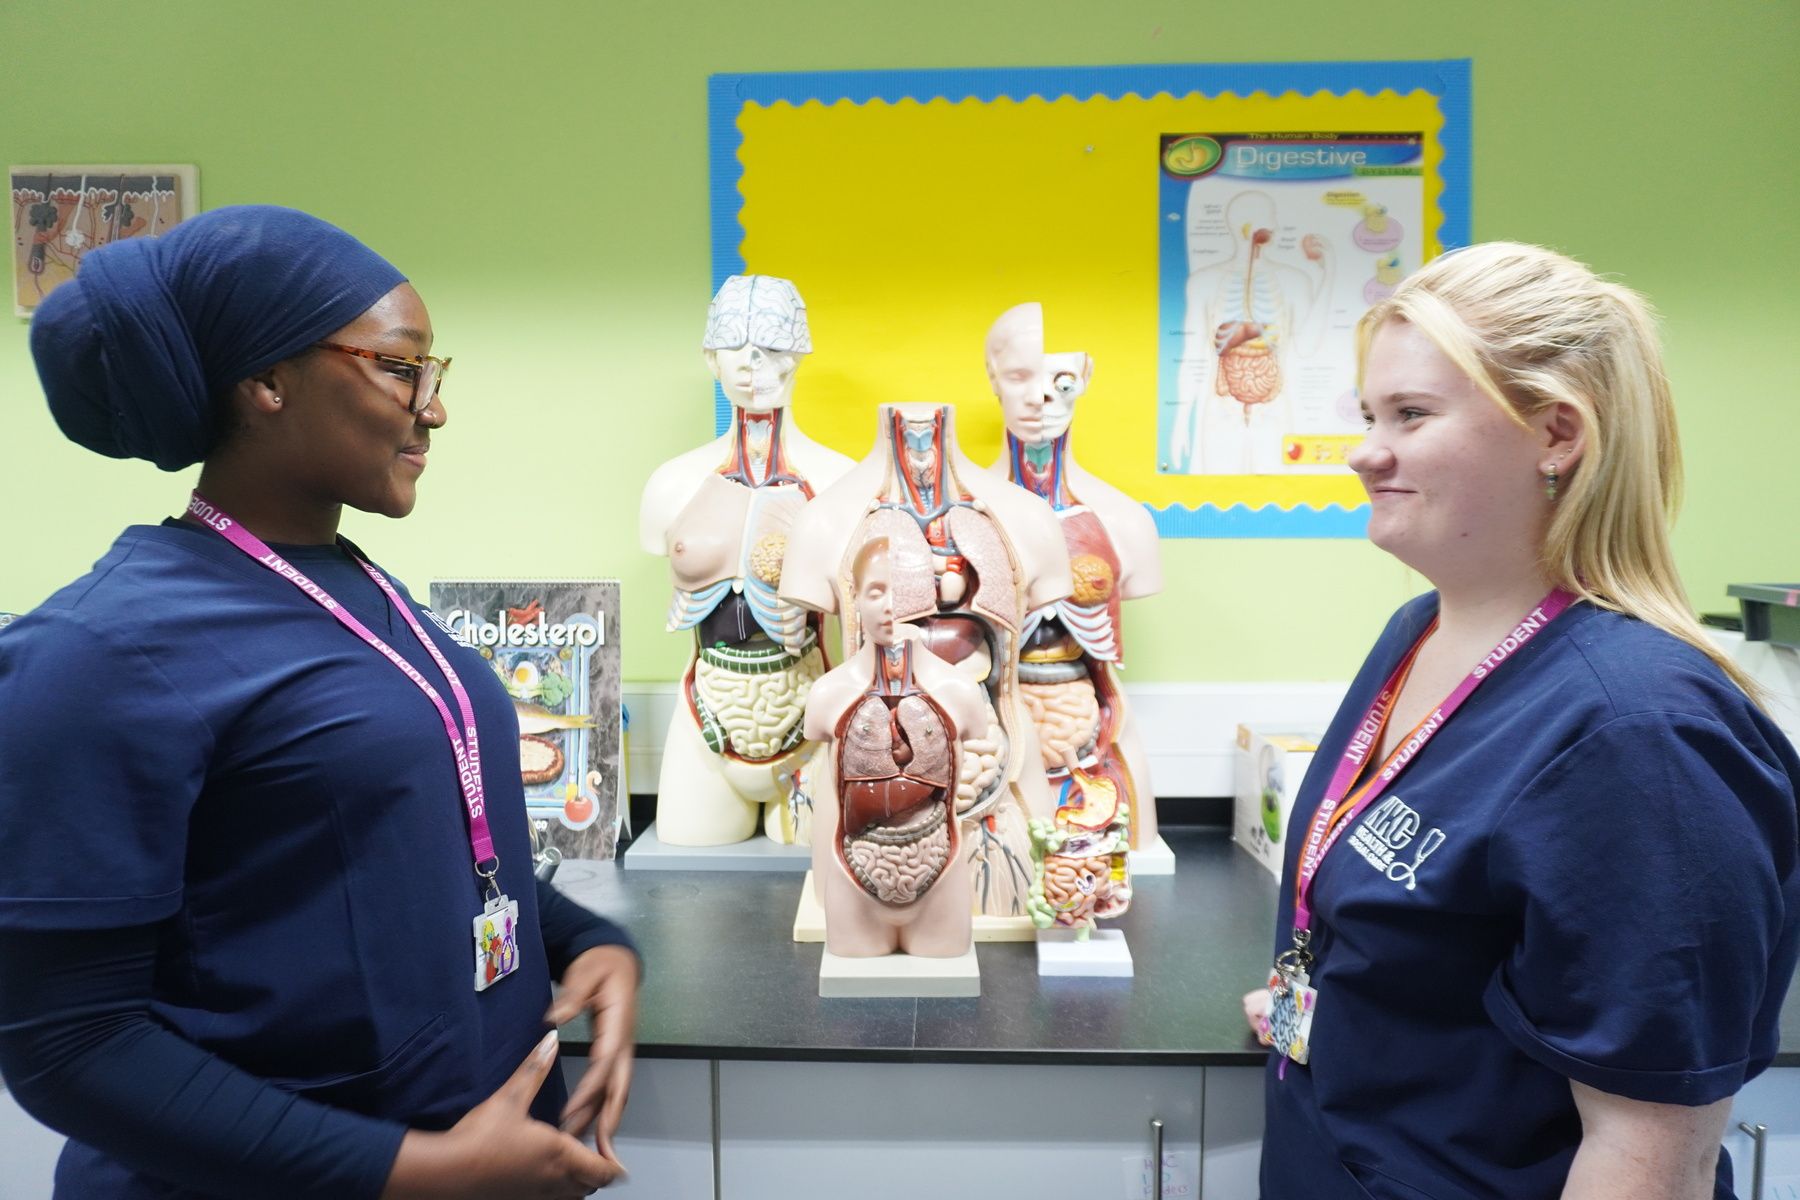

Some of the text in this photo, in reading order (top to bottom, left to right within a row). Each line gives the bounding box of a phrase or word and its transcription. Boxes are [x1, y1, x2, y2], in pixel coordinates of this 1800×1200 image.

[1236, 146, 1367, 170] Digestive
[1271, 132, 1310, 140] Human
[259, 554, 338, 609] STUDENT
[412, 623, 462, 687] STUDENT
[447, 610, 605, 647] Cholesterol
[1473, 607, 1549, 679] STUDENT
[368, 637, 438, 698] STUDENT
[1344, 690, 1393, 765] STUDENT
[1381, 708, 1445, 781] STUDENT
[452, 738, 483, 819] STUDENT
[467, 726, 485, 808] STUDE
[1302, 799, 1337, 880] STUDENT
[1310, 808, 1354, 873] TUDENT
[1347, 834, 1388, 873] SOCIAL CARE
[1354, 824, 1396, 865] HEALTH &
